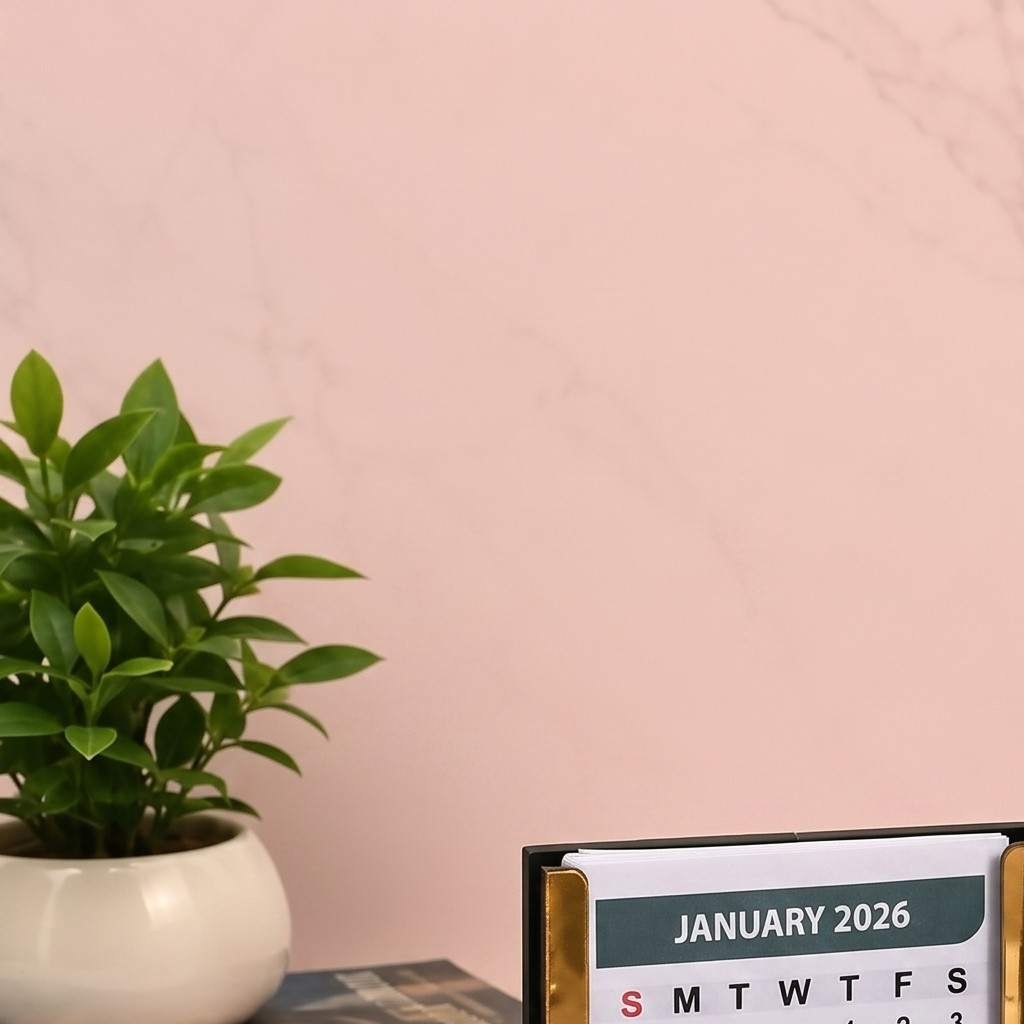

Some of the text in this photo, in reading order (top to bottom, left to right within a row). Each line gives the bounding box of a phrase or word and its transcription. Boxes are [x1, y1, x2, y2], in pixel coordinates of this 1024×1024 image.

[675, 901, 910, 943] JANUARY 2026
[622, 968, 967, 1017] S M T W T F S
